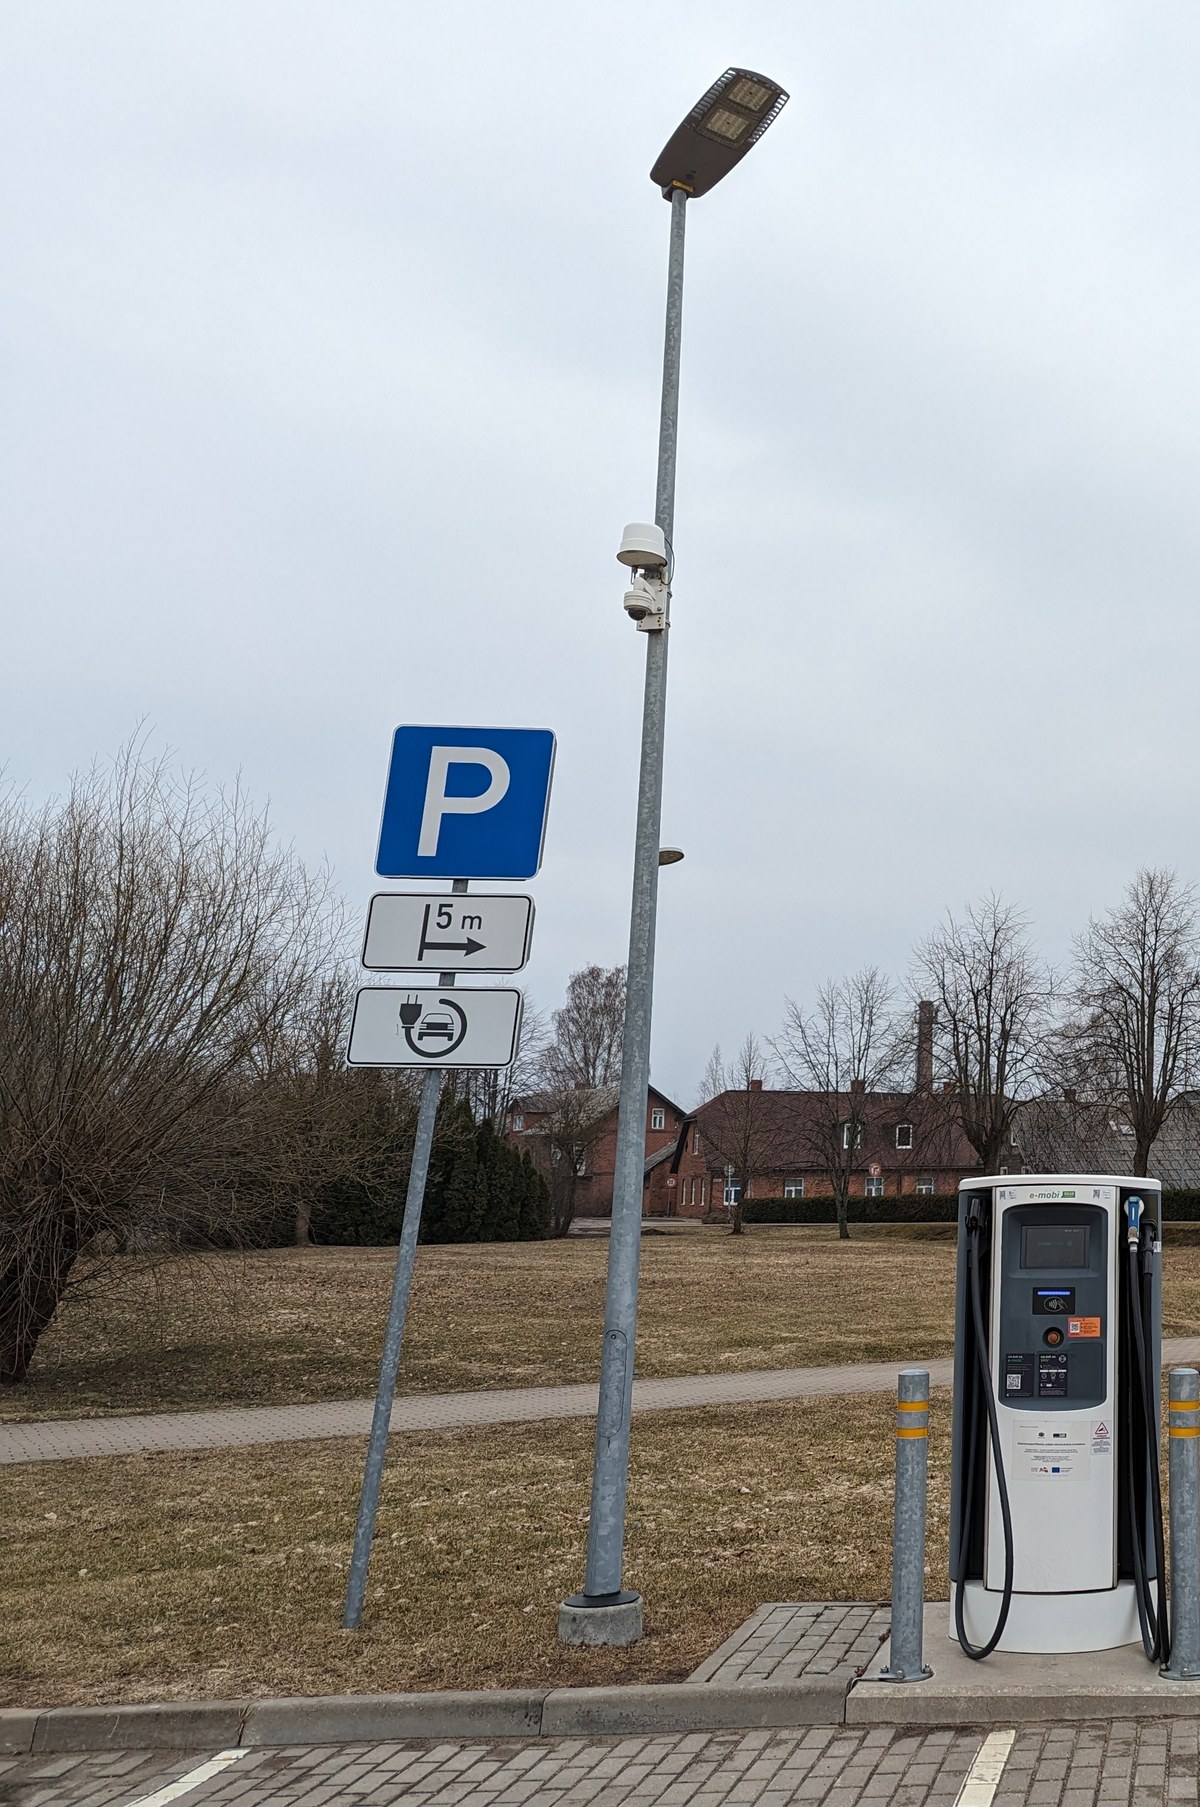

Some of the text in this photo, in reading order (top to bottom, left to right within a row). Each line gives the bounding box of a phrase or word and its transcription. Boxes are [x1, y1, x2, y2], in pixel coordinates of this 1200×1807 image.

[417, 745, 511, 857] P
[436, 903, 482, 930] 5 m
[1029, 1190, 1060, 1199] e-mobi
